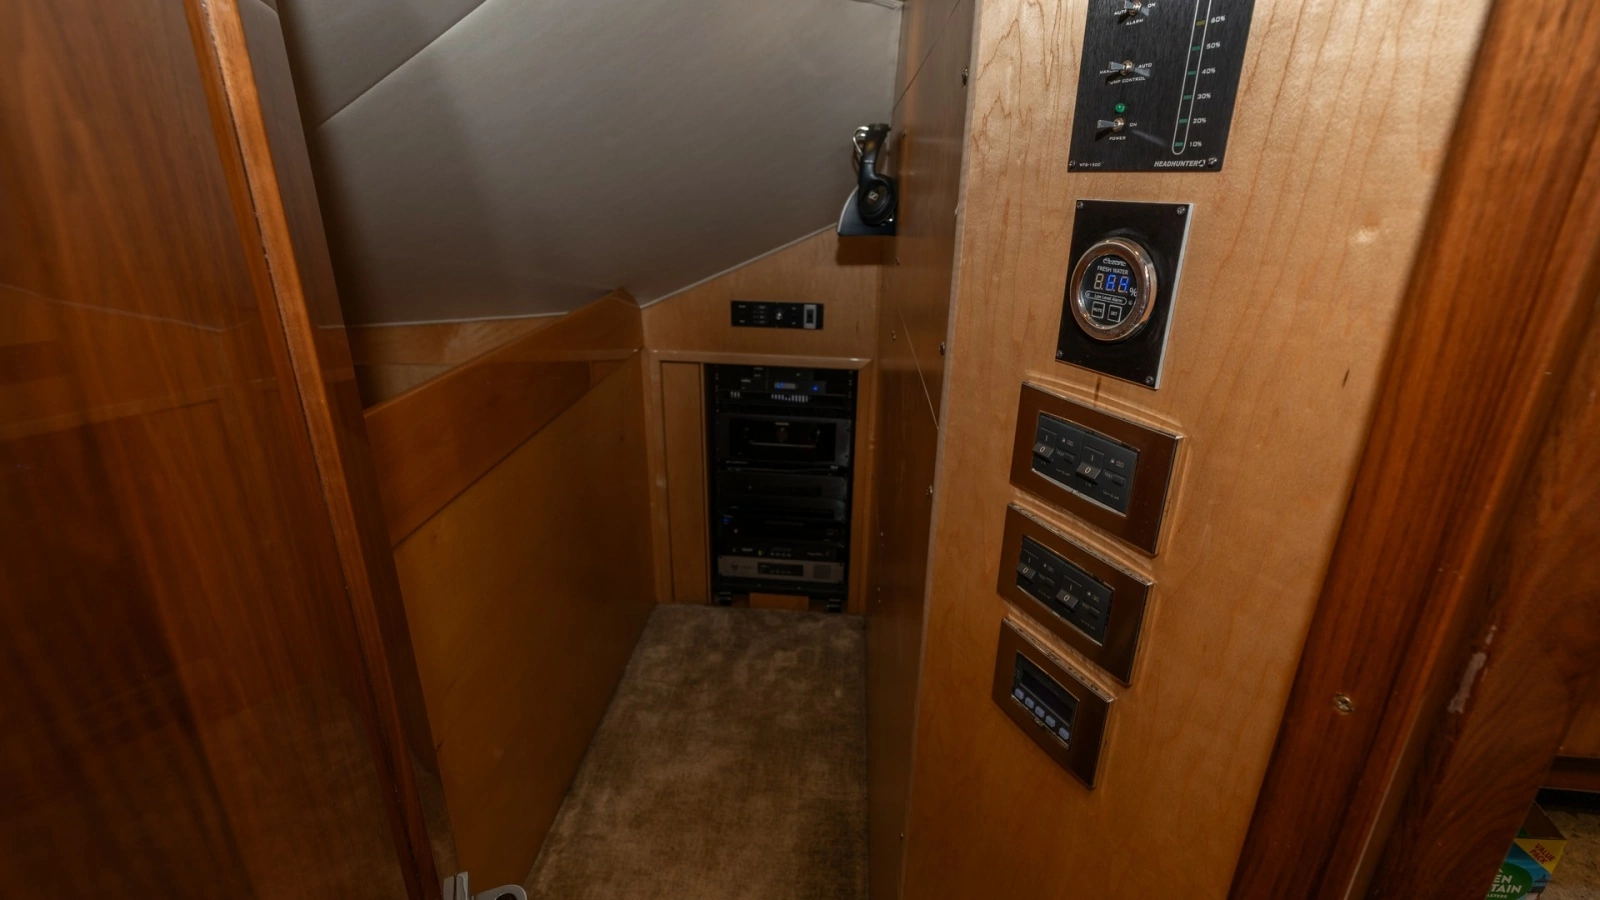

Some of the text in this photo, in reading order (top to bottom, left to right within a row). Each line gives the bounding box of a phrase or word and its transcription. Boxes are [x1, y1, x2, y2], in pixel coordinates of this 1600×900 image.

[1210, 15, 1226, 23] 60%
[1206, 41, 1221, 49] 50%
[1201, 67, 1216, 75] 40%
[1197, 92, 1211, 100] 30%
[1097, 265, 1112, 273] FRESH
[1529, 849, 1548, 864] PACK
[1535, 843, 1556, 862] VALUE
